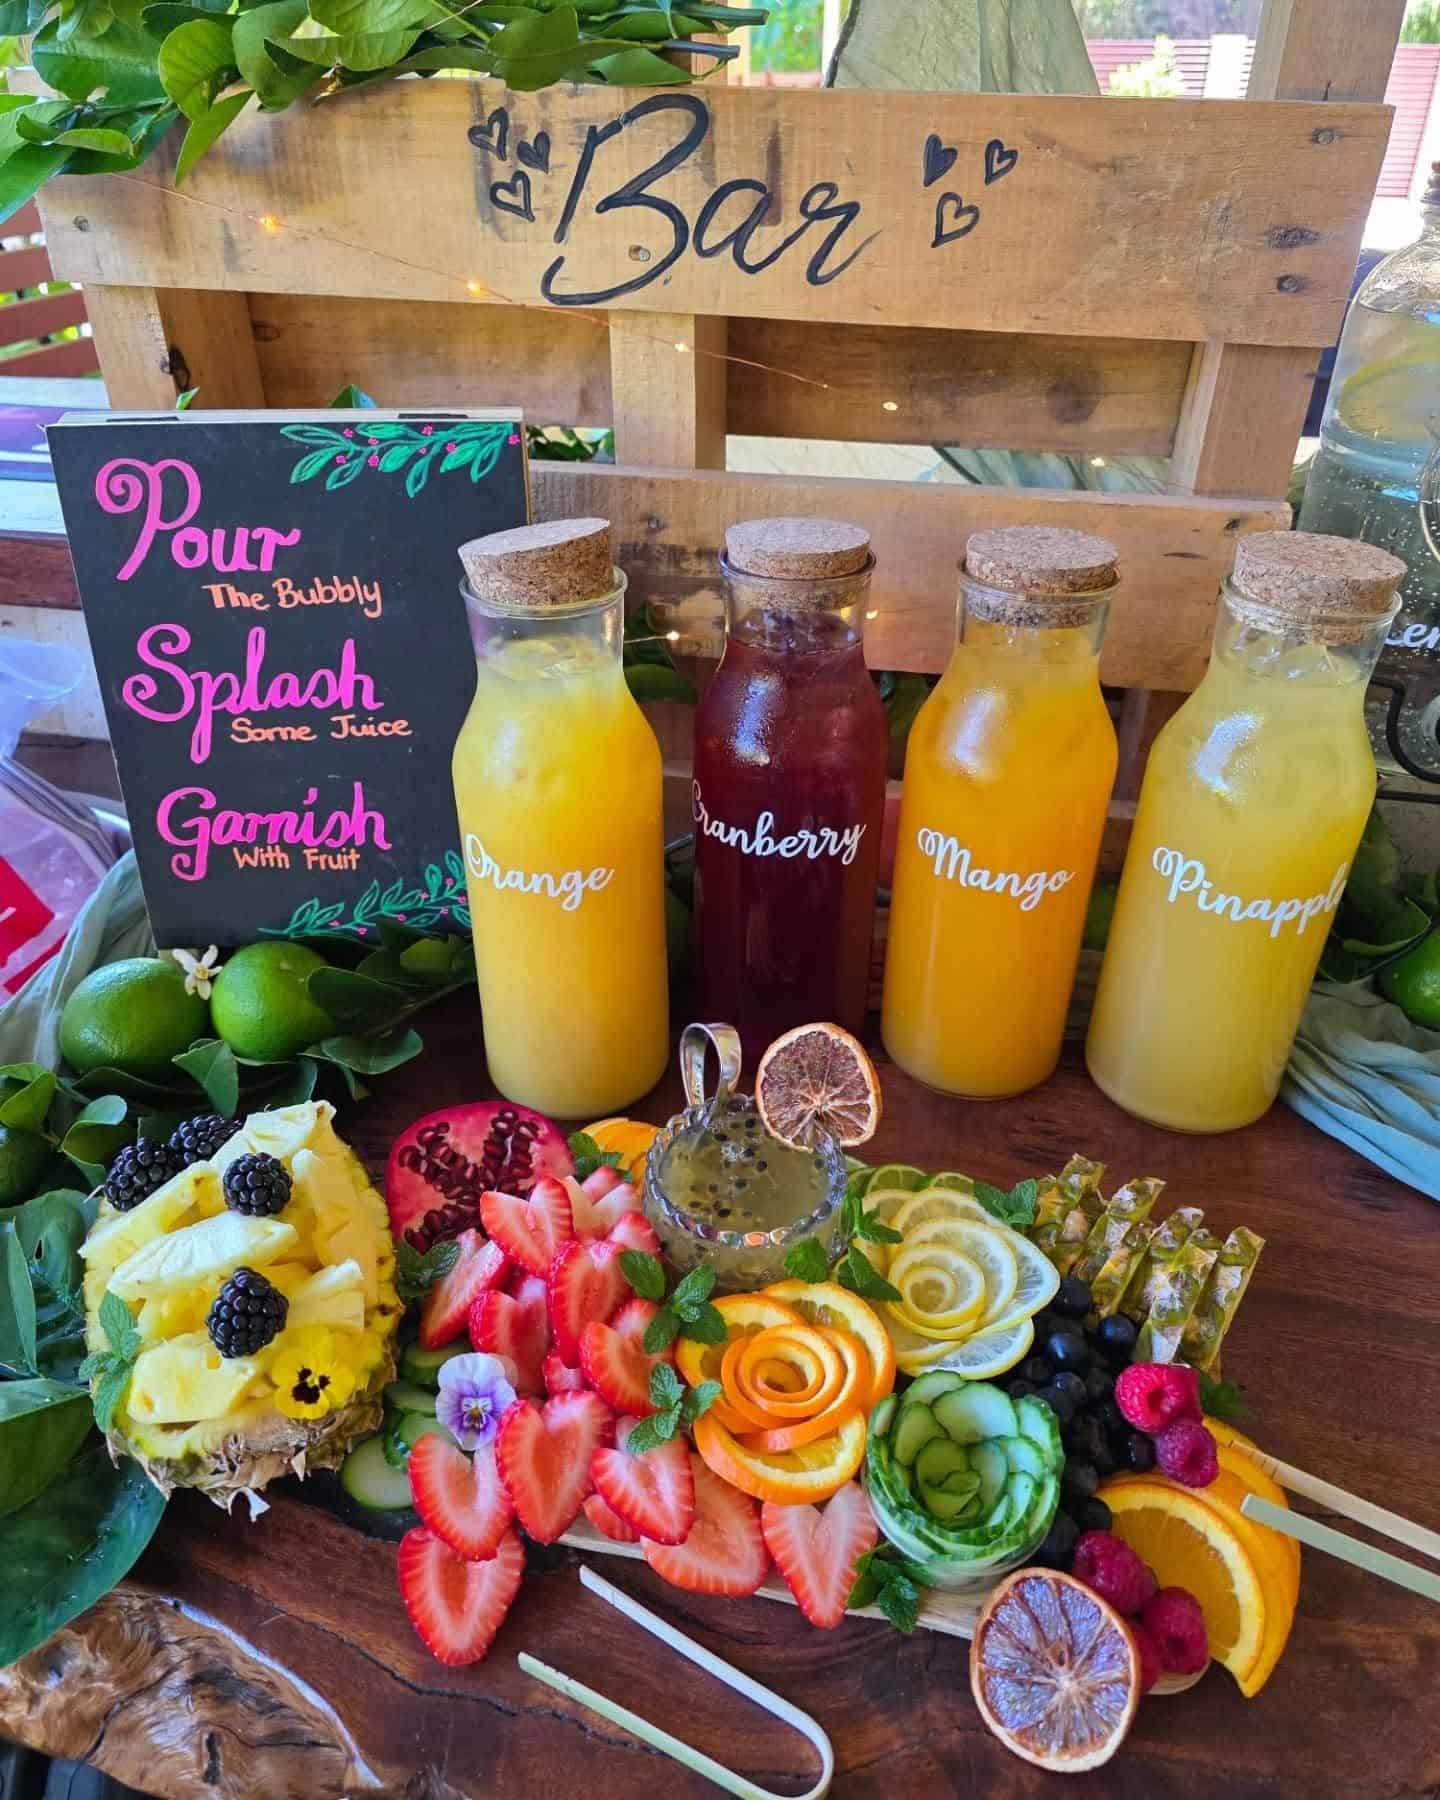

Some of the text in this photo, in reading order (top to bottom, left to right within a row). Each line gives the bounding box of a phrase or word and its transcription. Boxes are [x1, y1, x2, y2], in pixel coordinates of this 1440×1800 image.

[541, 94, 882, 305] Bar
[95, 457, 301, 581] Pour
[202, 576, 383, 619] The Bubbly
[122, 623, 385, 764] Splash
[230, 715, 413, 744] Some Juice
[156, 782, 392, 882] Garnish
[232, 846, 361, 871] With Fruit
[692, 779, 867, 866] Cranberry
[465, 832, 615, 912] Orange
[917, 828, 1077, 912] Mango
[1152, 846, 1348, 939] Pinappl
